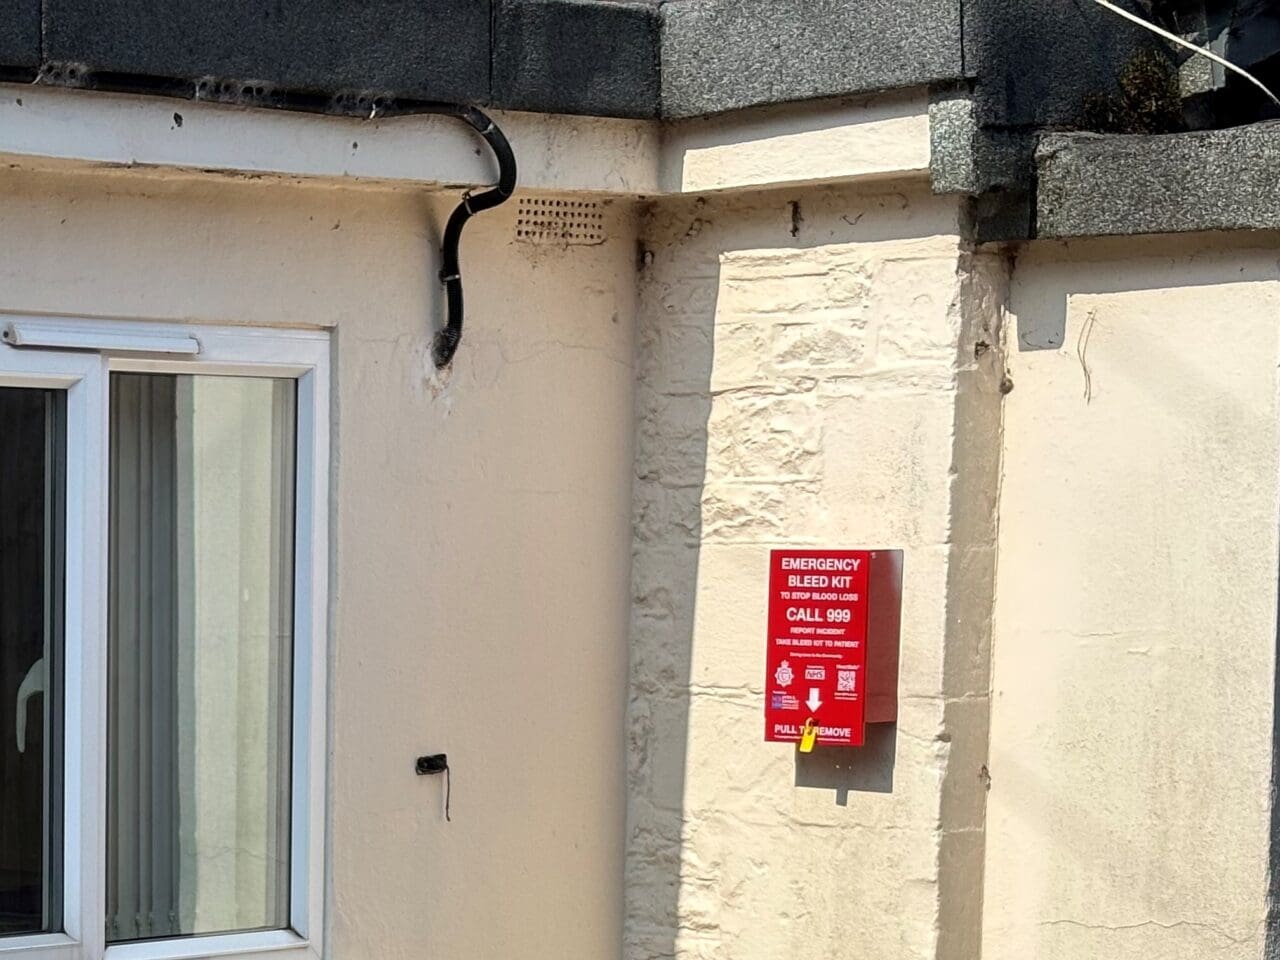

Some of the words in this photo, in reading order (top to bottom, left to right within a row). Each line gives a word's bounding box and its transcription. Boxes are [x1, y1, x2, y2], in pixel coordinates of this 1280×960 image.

[781, 557, 861, 572] EMERGENCY
[787, 575, 829, 588] BLEED
[831, 575, 853, 589] KIT
[780, 591, 791, 600] TO
[791, 591, 811, 600] STOP
[811, 592, 838, 601] BLOOD
[838, 593, 859, 602] LOSS
[786, 607, 824, 622] CALL
[826, 608, 851, 623] 999
[774, 724, 798, 735] PULL
